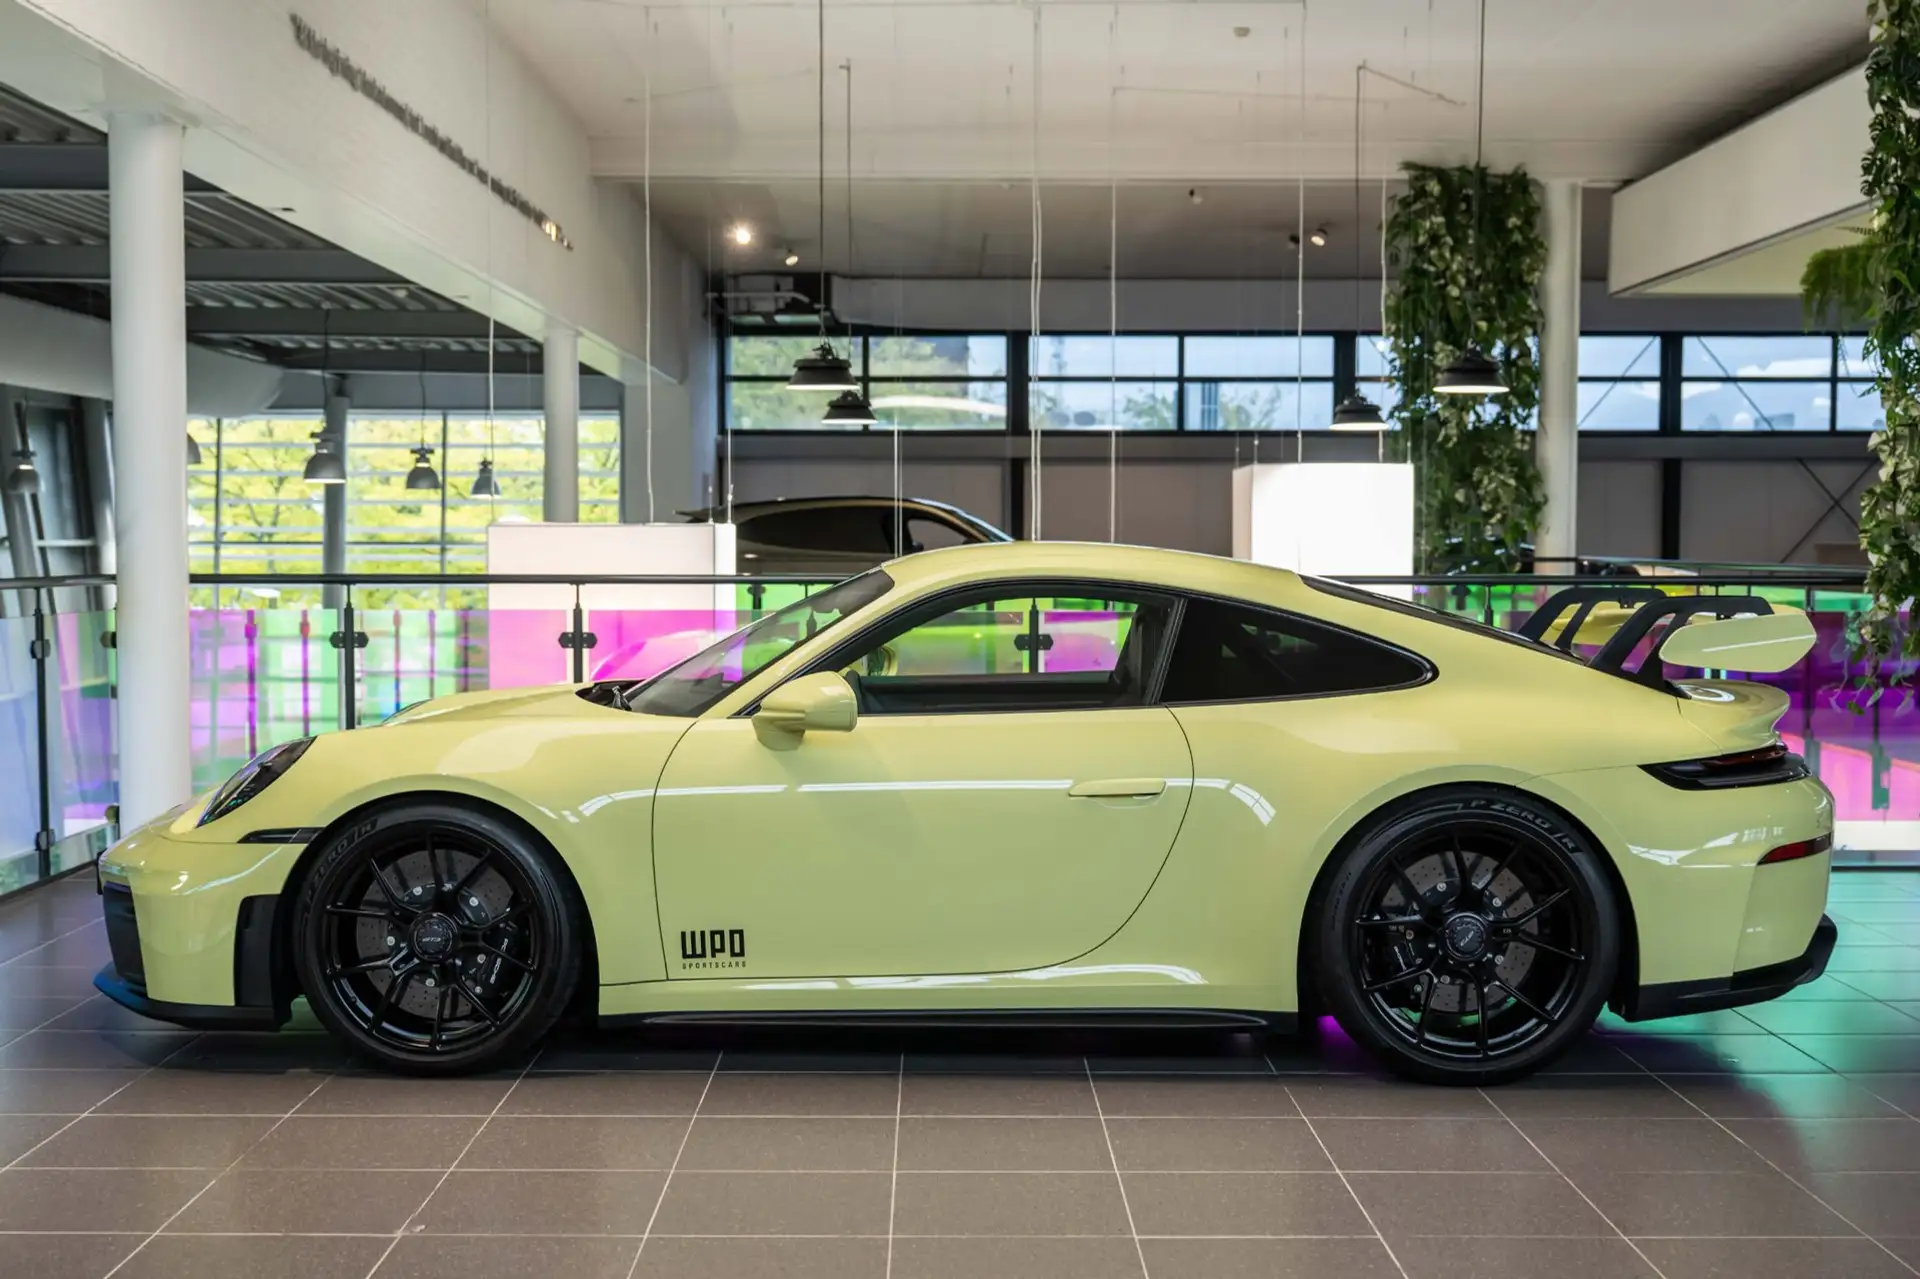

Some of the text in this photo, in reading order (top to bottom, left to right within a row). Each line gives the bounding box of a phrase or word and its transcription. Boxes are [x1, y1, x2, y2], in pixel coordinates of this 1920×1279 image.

[1490, 802, 1552, 829] ZERO
[681, 929, 746, 959] WPO
[682, 960, 747, 970] SPORTSCARS
